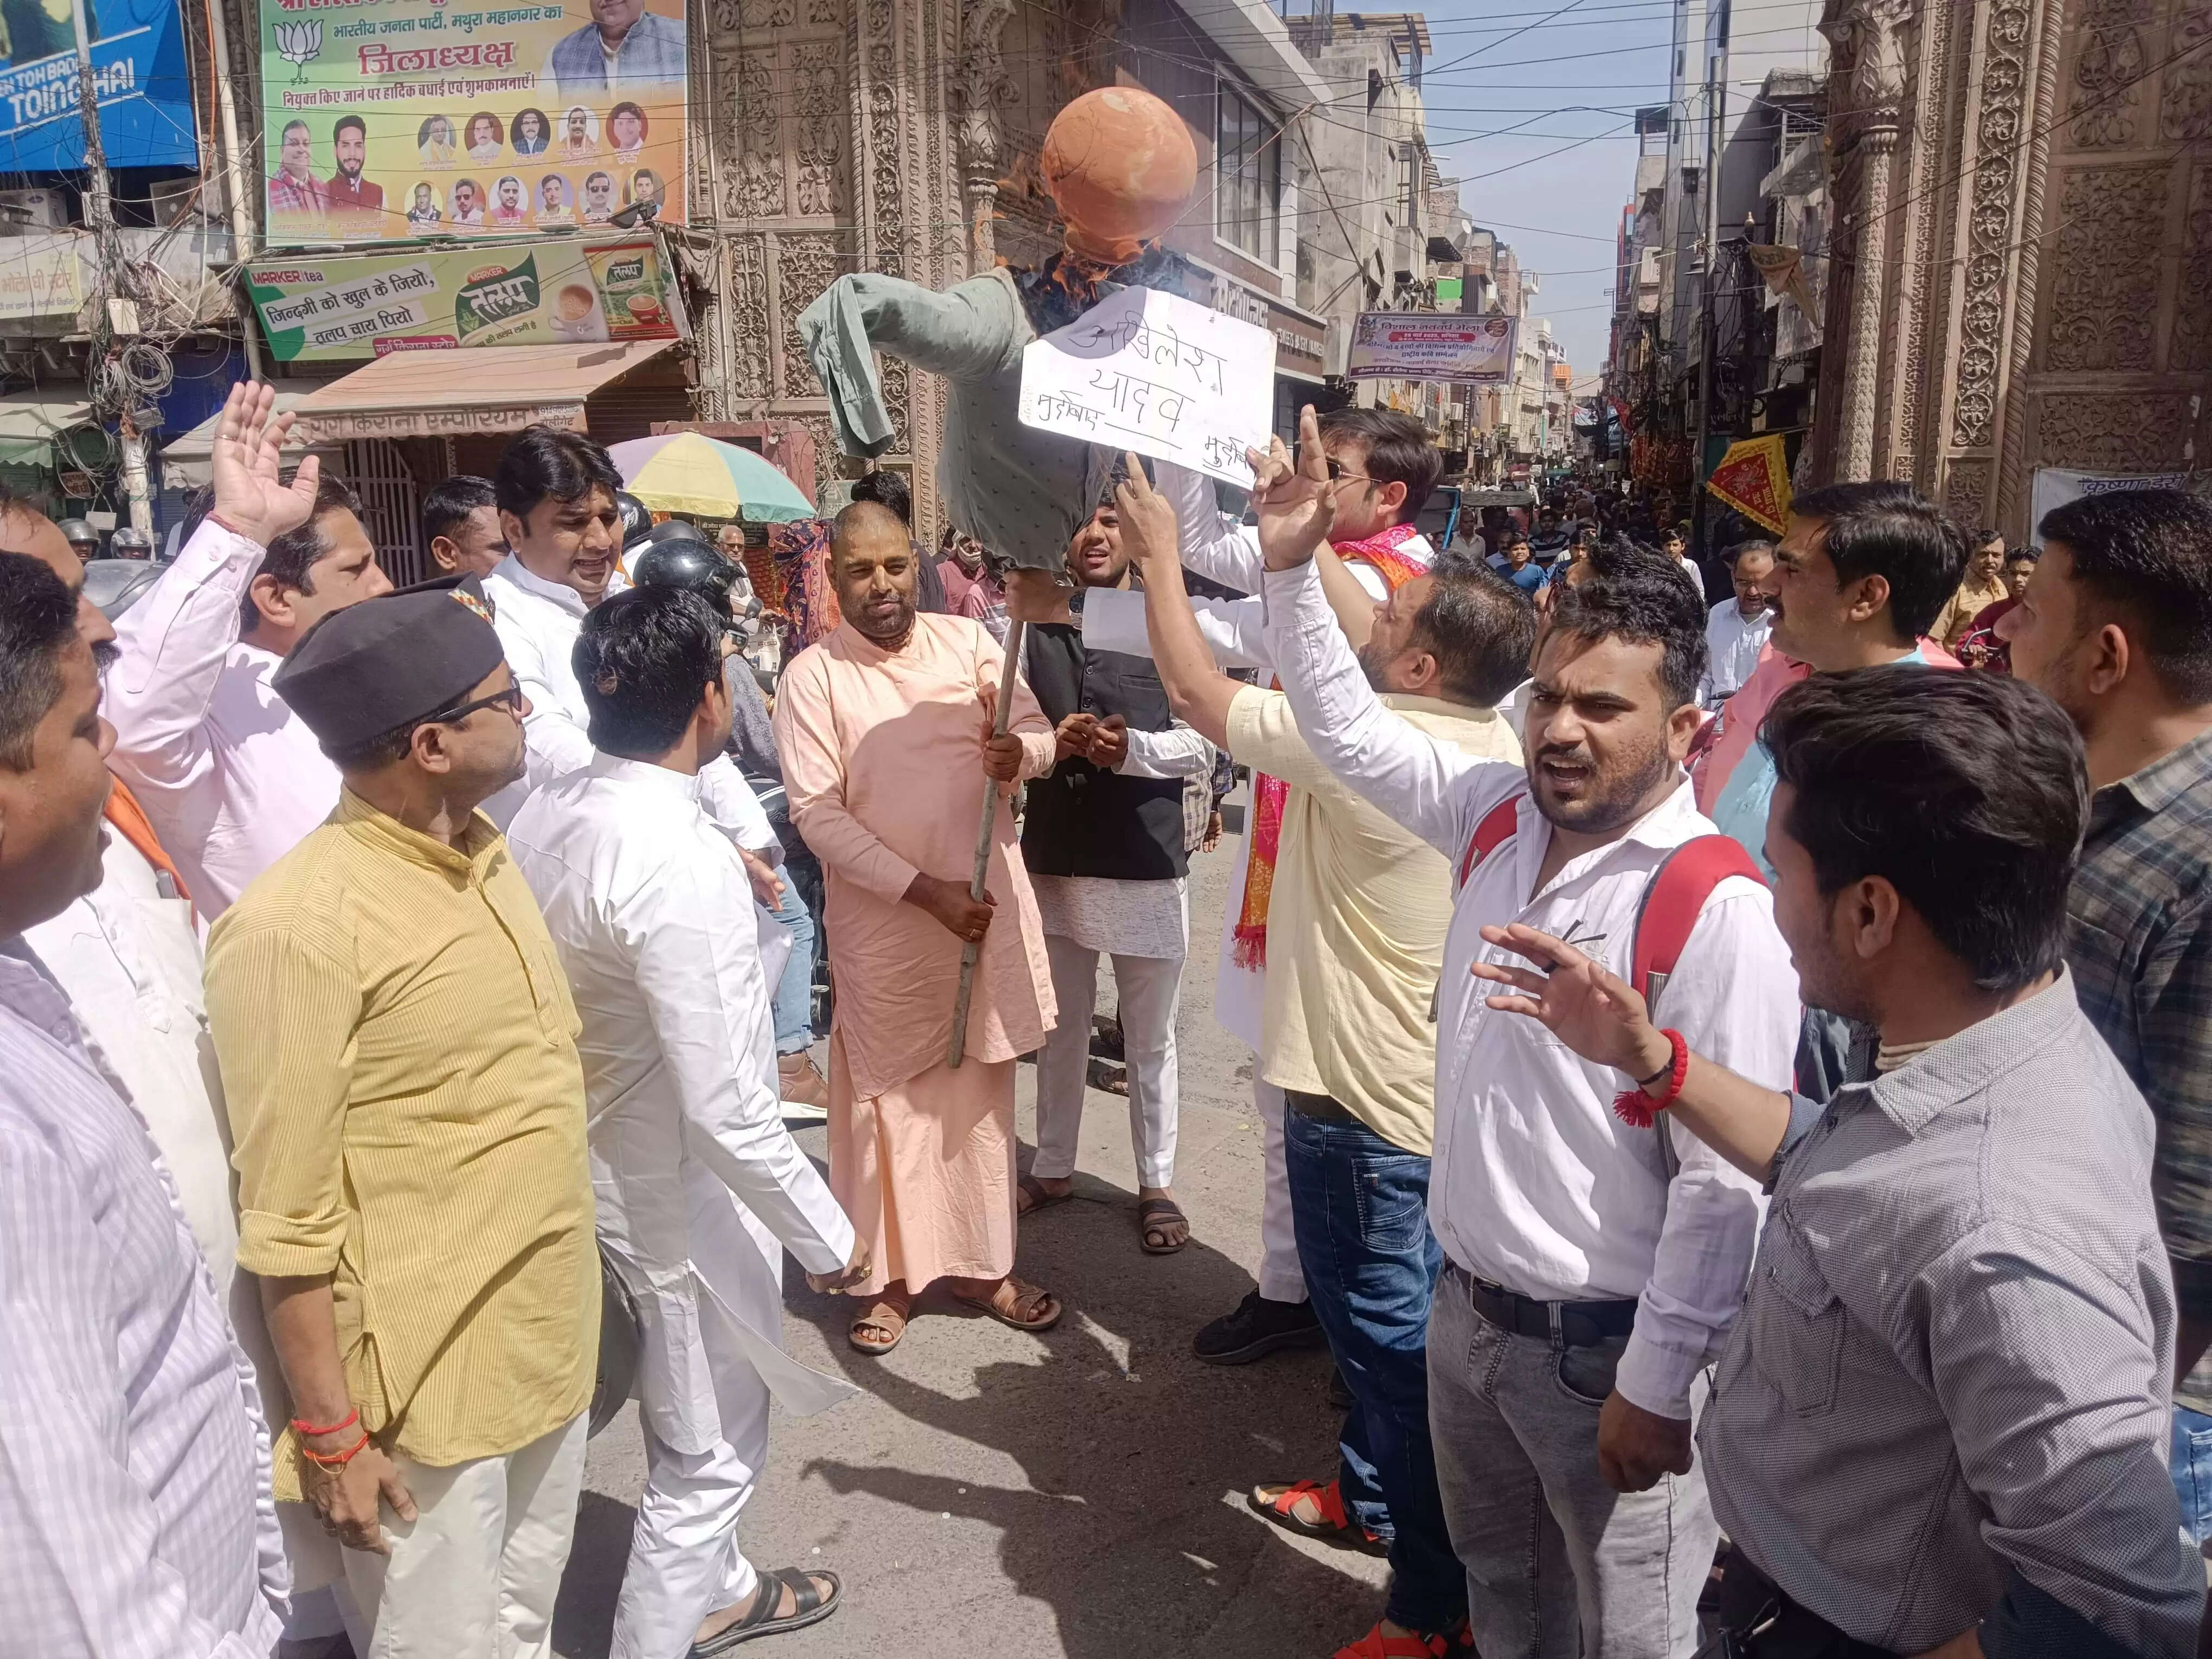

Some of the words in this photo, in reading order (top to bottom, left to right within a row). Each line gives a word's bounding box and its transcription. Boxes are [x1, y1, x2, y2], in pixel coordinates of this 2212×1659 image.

[333, 18, 376, 38] भारतीय
[380, 19, 415, 34] जनता
[418, 11, 447, 30] पार्टी,
[451, 12, 483, 33] मथुरा
[486, 8, 541, 24] महानगर
[543, 5, 562, 19] का
[357, 41, 515, 75] जिलाध्यक्ष
[8, 75, 81, 124] TOING
[93, 57, 134, 99] HAI
[16, 66, 48, 90] TOH
[283, 91, 317, 108] नियुक्त
[319, 89, 340, 104] किए
[343, 85, 364, 102] जाने
[368, 87, 382, 100] पर
[384, 81, 416, 99] हार्दिक
[419, 78, 445, 97] बधाई
[448, 76, 465, 95] एवं
[251, 270, 301, 285] MARKER
[306, 271, 324, 282] tea
[470, 267, 504, 281] MARKER
[266, 297, 319, 324] जिन्दगी
[319, 292, 340, 311] को
[341, 287, 371, 310] खुल
[372, 279, 389, 297] के
[389, 268, 435, 293] जियो,
[312, 326, 347, 345] तलप
[348, 320, 378, 337] चाय
[377, 306, 414, 329] पियो
[1089, 369, 1195, 432] यादव
[350, 410, 421, 434] किराना
[423, 407, 530, 430] एम्पोरियम
